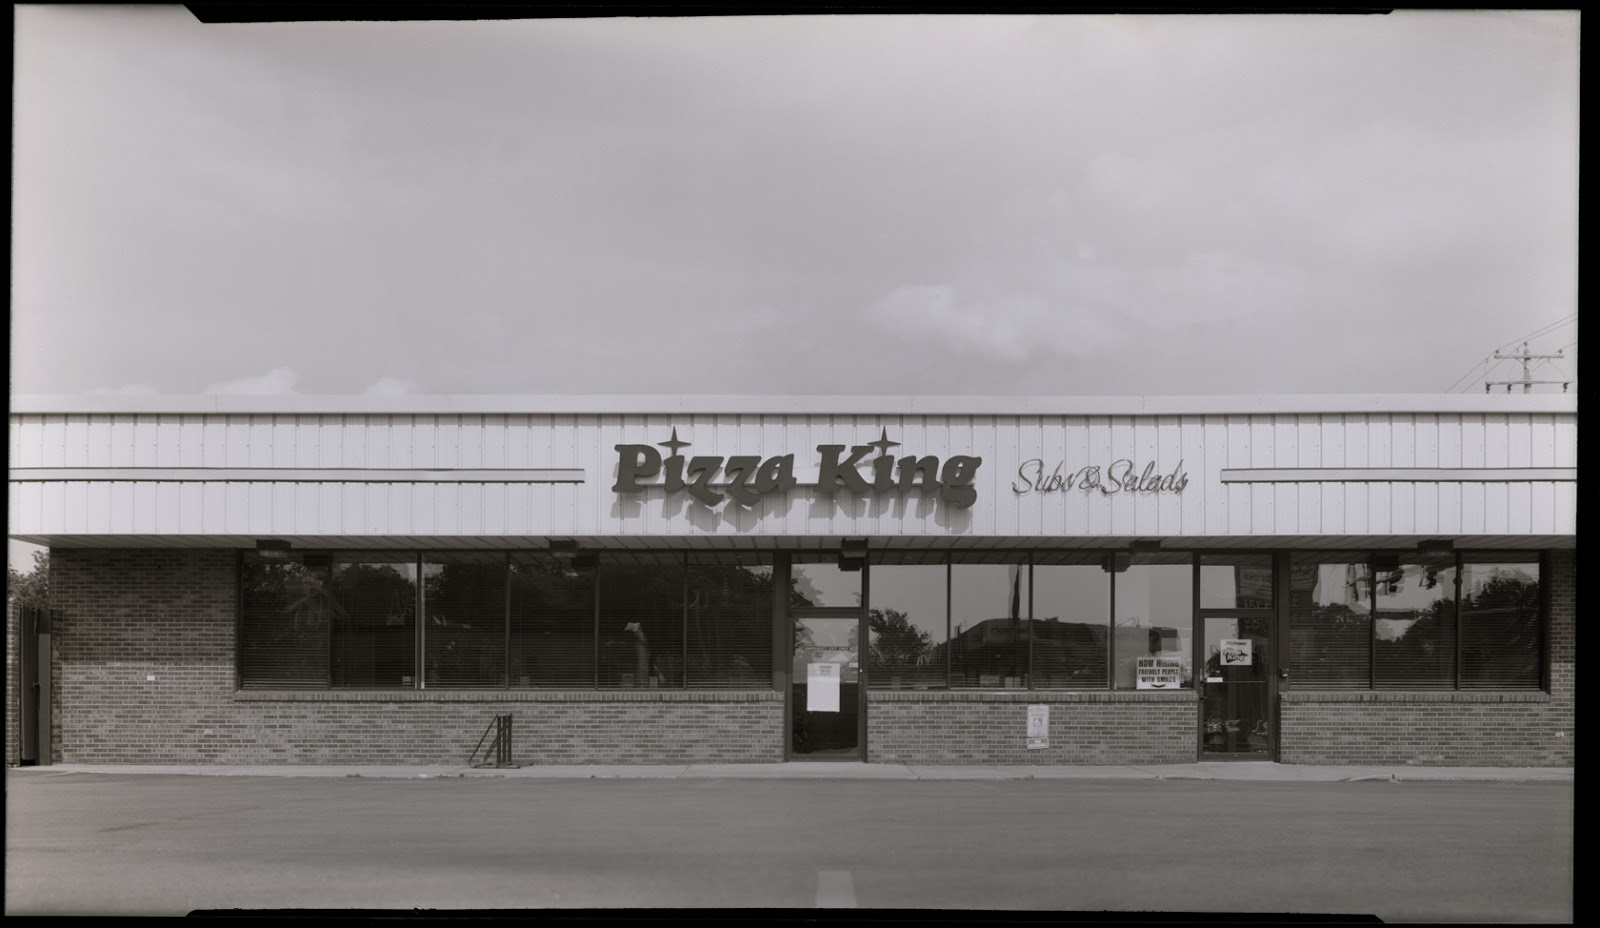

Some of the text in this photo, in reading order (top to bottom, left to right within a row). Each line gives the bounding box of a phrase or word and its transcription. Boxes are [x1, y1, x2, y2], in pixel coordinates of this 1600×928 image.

[612, 425, 983, 510] Pizza King
[1012, 458, 1188, 495] Subs & Salads
[1138, 659, 1154, 667] NOW
